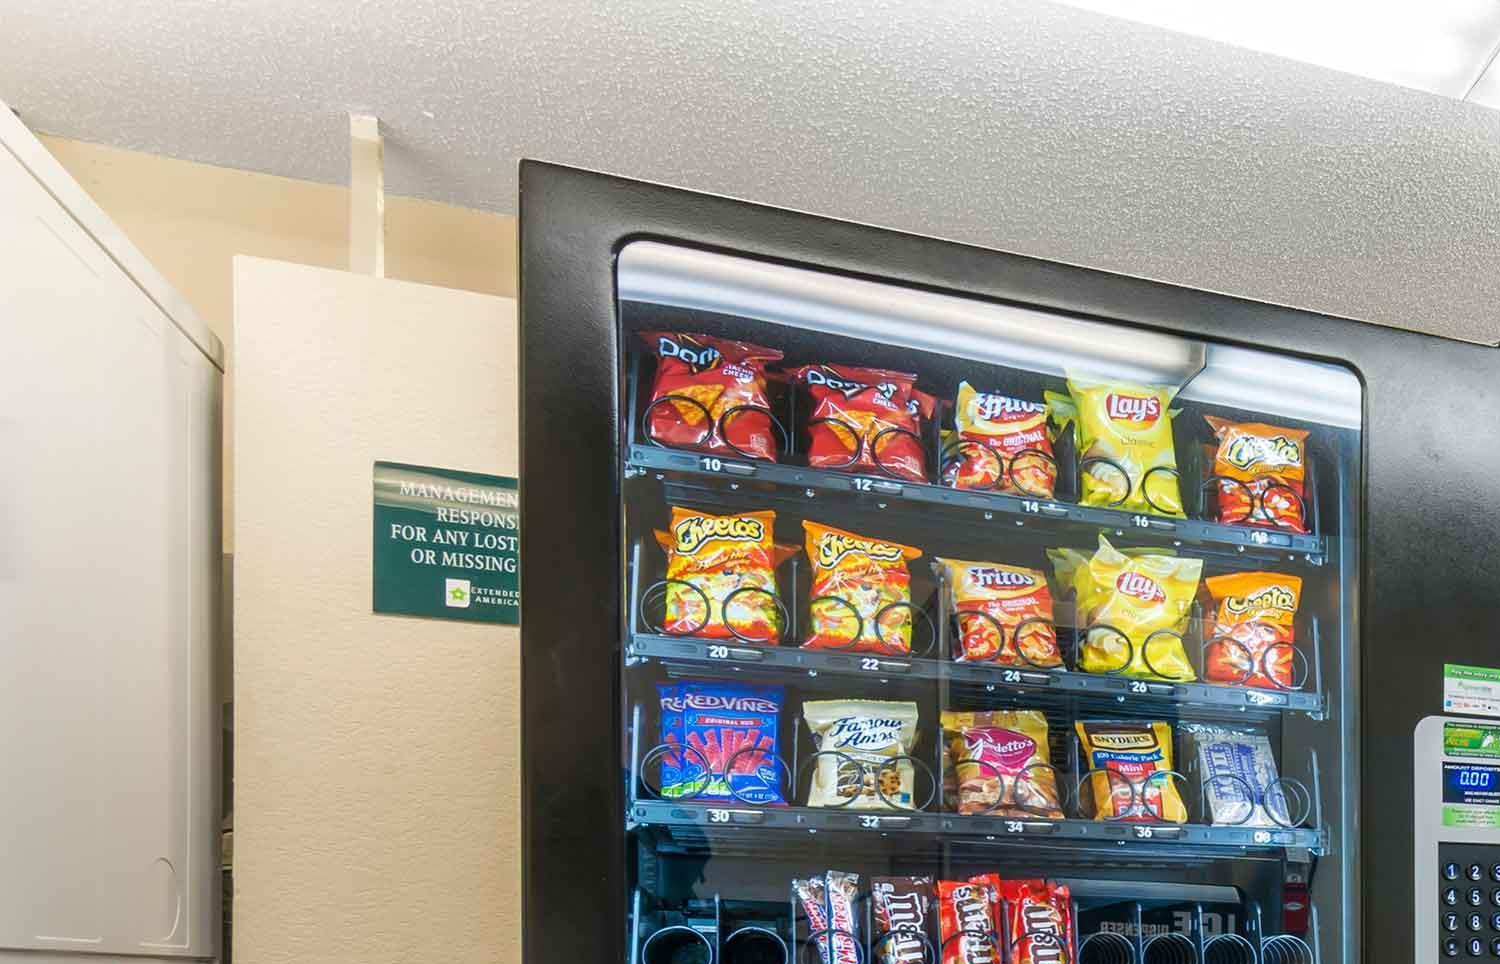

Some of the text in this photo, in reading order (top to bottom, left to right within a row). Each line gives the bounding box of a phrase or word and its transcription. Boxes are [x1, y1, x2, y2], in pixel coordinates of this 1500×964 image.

[659, 336, 720, 365] Dori
[1110, 393, 1160, 421] Lay's
[703, 458, 722, 472] 10
[854, 478, 872, 491] 12
[400, 482, 519, 507] MANAGEMEN
[1022, 500, 1040, 513] 14
[437, 507, 519, 530] RESPONS
[1134, 516, 1149, 528] 16
[391, 524, 427, 542] FOR
[432, 530, 469, 546] ANY
[674, 516, 764, 555] Cheetos
[411, 549, 517, 573] OR MISSING
[966, 566, 1036, 589] Fritos
[471, 586, 520, 599] EXTENDED
[475, 596, 519, 606] AMERICA
[709, 645, 728, 659] 20
[862, 657, 879, 671] 22
[1005, 670, 1021, 683] 24
[1132, 681, 1148, 694] 26
[720, 697, 781, 714] VINES
[705, 717, 739, 727] ORIGINAL
[1093, 734, 1152, 746] SNYDER'S
[1110, 752, 1140, 763] Calorie
[1140, 753, 1161, 763] Pack
[1118, 763, 1144, 774] Mini
[711, 810, 730, 824] 30
[861, 815, 879, 829] 32
[1007, 820, 1025, 833] 34
[1137, 827, 1152, 840] 36
[1448, 865, 1455, 876] 1
[1472, 866, 1480, 877] 2
[1447, 890, 1455, 902] 4
[1472, 891, 1480, 902] 5
[1449, 916, 1456, 928] 7
[1472, 916, 1480, 928] 8
[1472, 940, 1480, 952] 0
